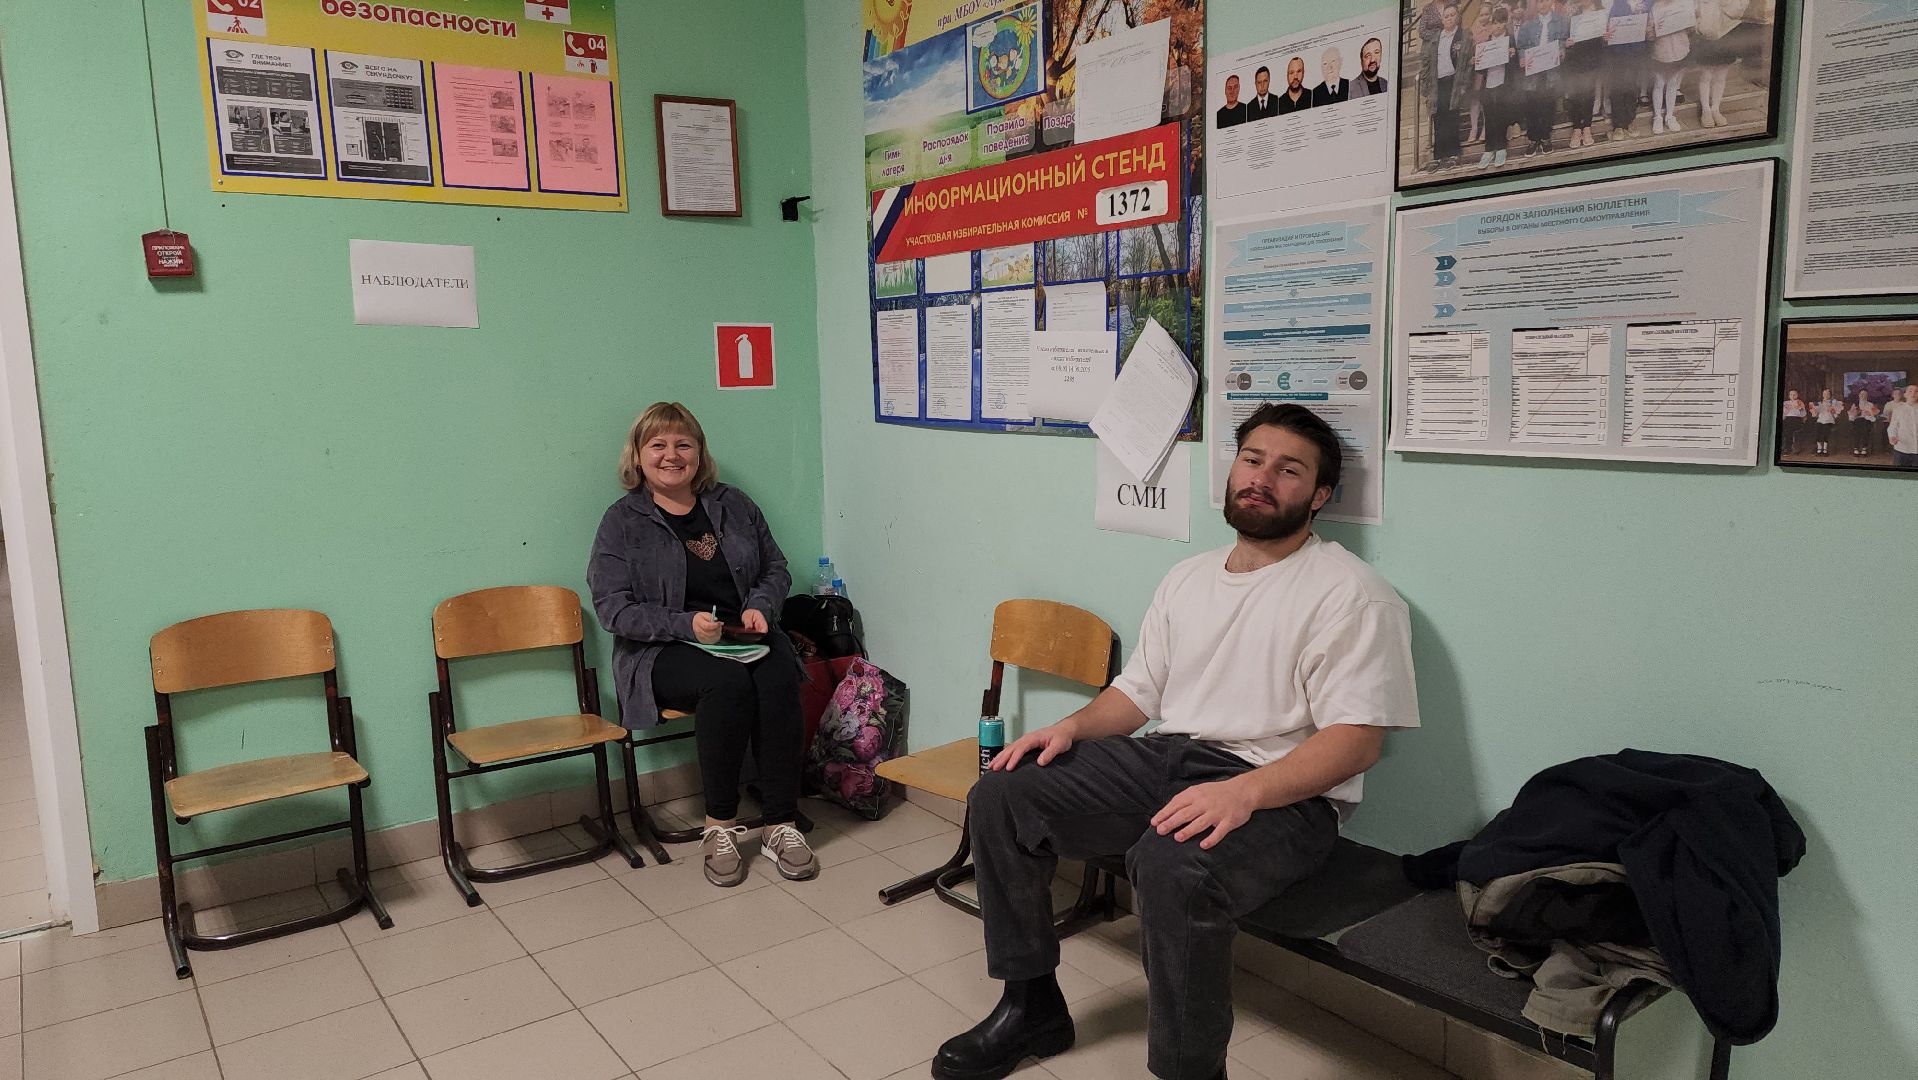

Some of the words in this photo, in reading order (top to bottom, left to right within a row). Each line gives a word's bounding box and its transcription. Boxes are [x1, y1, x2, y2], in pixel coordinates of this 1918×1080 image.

[322, 0, 517, 37] безопасности
[588, 37, 606, 52] 04
[987, 116, 1025, 135] Правила
[922, 132, 969, 152] Распорядок
[983, 134, 1029, 154] поведения
[939, 153, 952, 166] дня
[881, 163, 904, 178] лагеря
[904, 153, 1086, 216] ИНФОРМАЦИОННЫЙ
[1091, 142, 1166, 180] СТЕНД
[906, 230, 952, 247] УЧАСТКОВАЯ
[953, 218, 1020, 239] ИЗБИРАТЕЛЬНАЯ
[1021, 210, 1071, 228] КОМИССИЯ
[1077, 208, 1088, 220] №
[1109, 187, 1151, 217] 1372
[1480, 211, 1521, 225] ПОРЯДОК
[1522, 205, 1585, 220] ЗАПОЛНЕНИЯ
[1587, 197, 1647, 212] БЮЛЛЕТЕНЯ
[1477, 225, 1505, 235] ВЫБОРЫ
[1511, 221, 1540, 231] ОРГАНЫ
[1540, 217, 1578, 228] МЕСТНОГО
[1579, 209, 1650, 224] САМОУПРАВЛЕНИЯ
[361, 274, 469, 289] НАБЛЮДАТЕЛИ
[1117, 483, 1167, 509] СМИ
